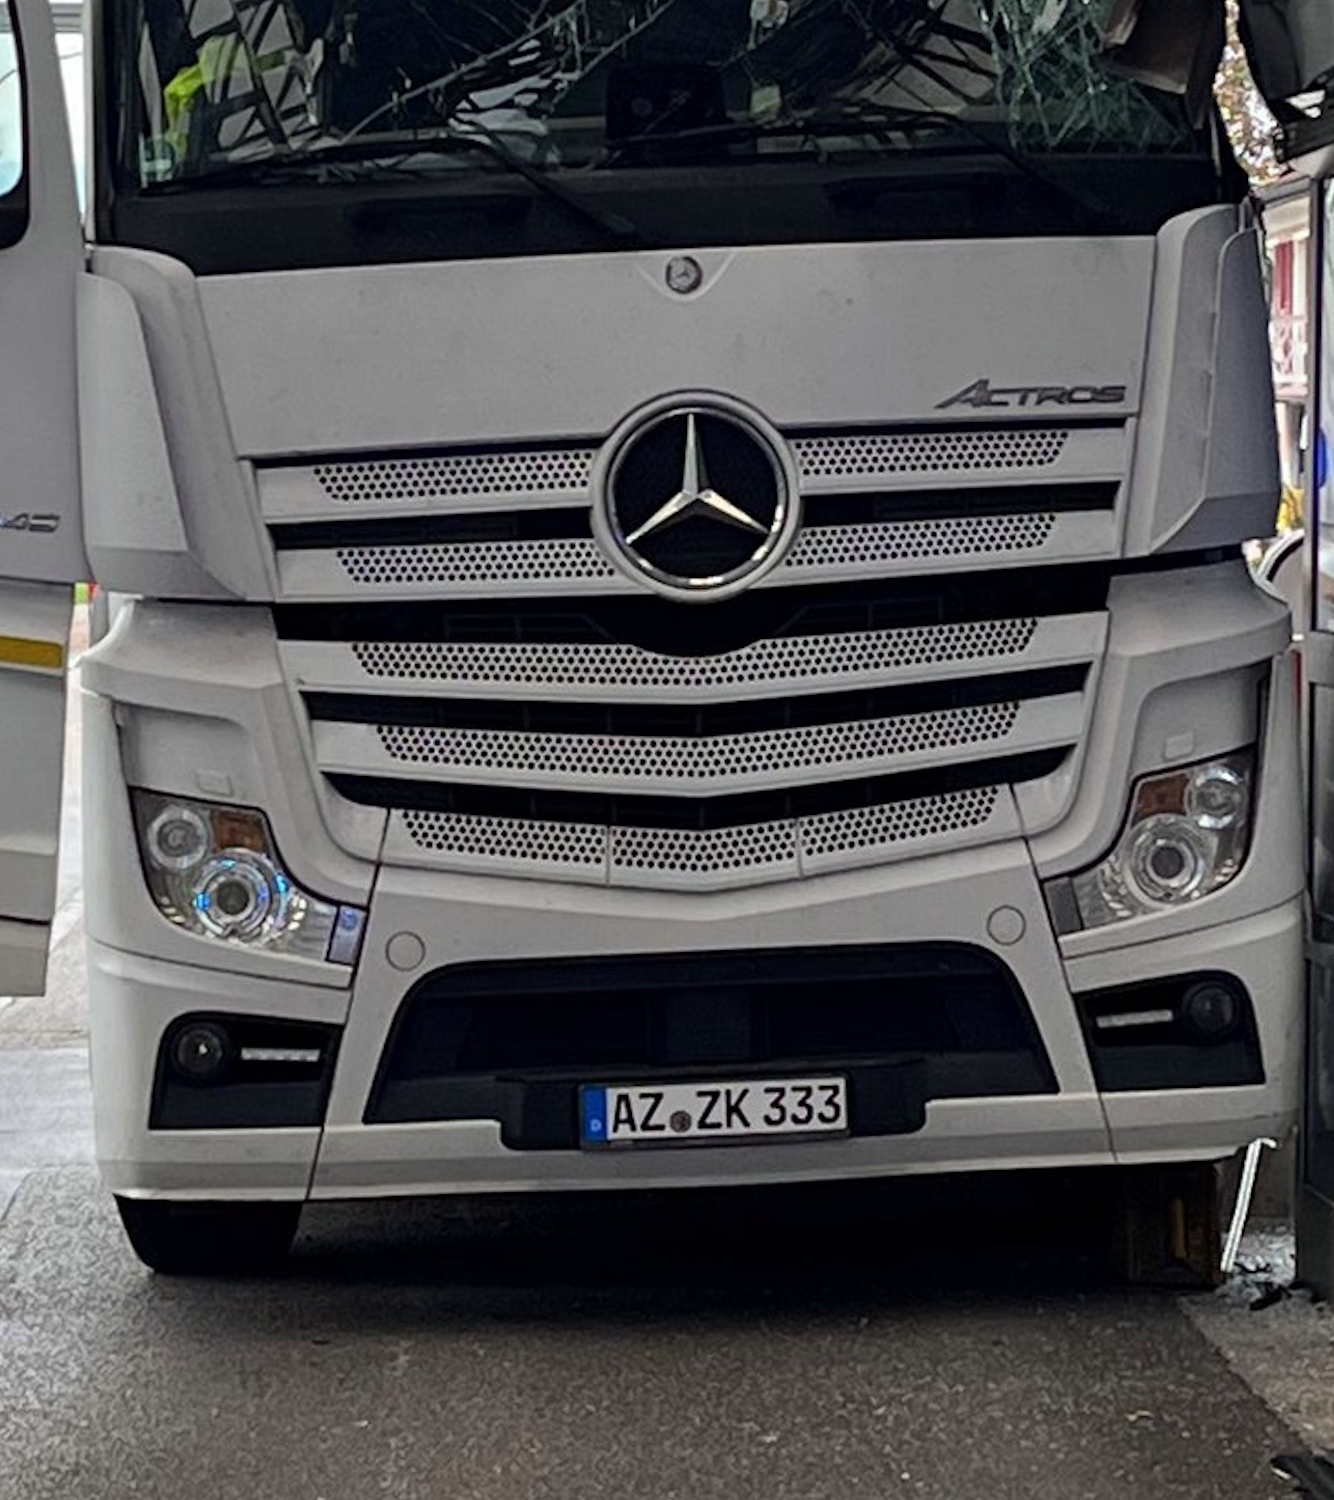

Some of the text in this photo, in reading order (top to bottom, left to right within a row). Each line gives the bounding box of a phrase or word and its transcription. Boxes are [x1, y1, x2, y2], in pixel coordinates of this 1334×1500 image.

[612, 1085, 841, 1133] AZ ZK 333
